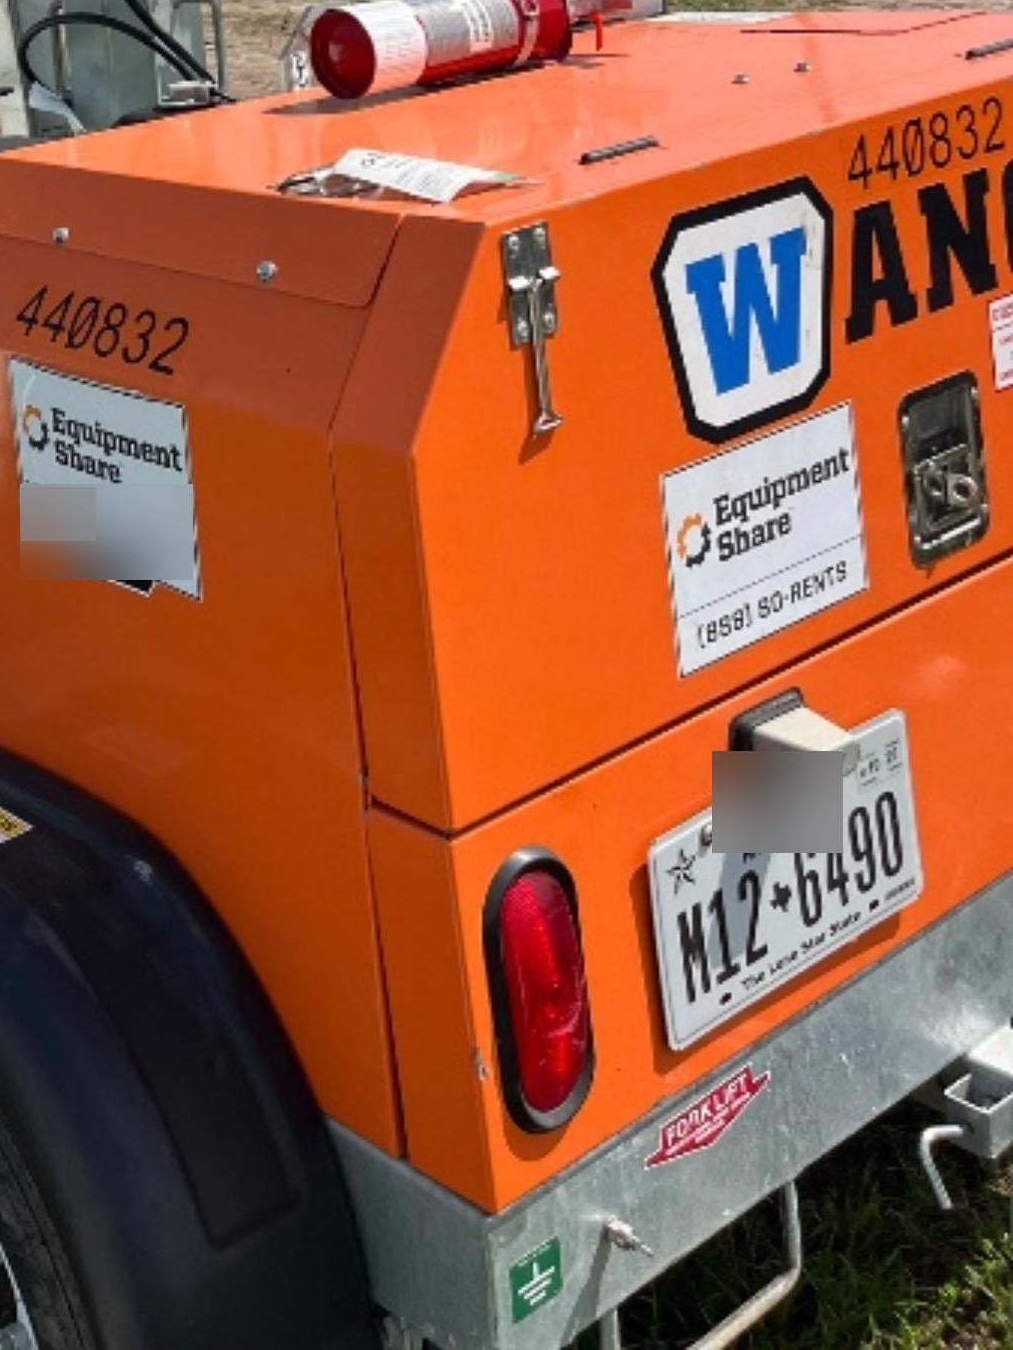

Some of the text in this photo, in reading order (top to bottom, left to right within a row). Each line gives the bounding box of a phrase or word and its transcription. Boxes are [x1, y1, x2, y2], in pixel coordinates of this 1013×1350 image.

[847, 96, 1005, 190] 440832
[15, 284, 190, 376] 440832
[50, 406, 184, 472] Equipment
[54, 441, 123, 484] Share
[713, 446, 850, 526] Equipment
[715, 511, 793, 562] Share
[697, 607, 753, 649] (858)
[677, 869, 768, 1003] M12
[742, 967, 765, 991] The
[800, 932, 826, 954] Star
[829, 911, 862, 936] State
